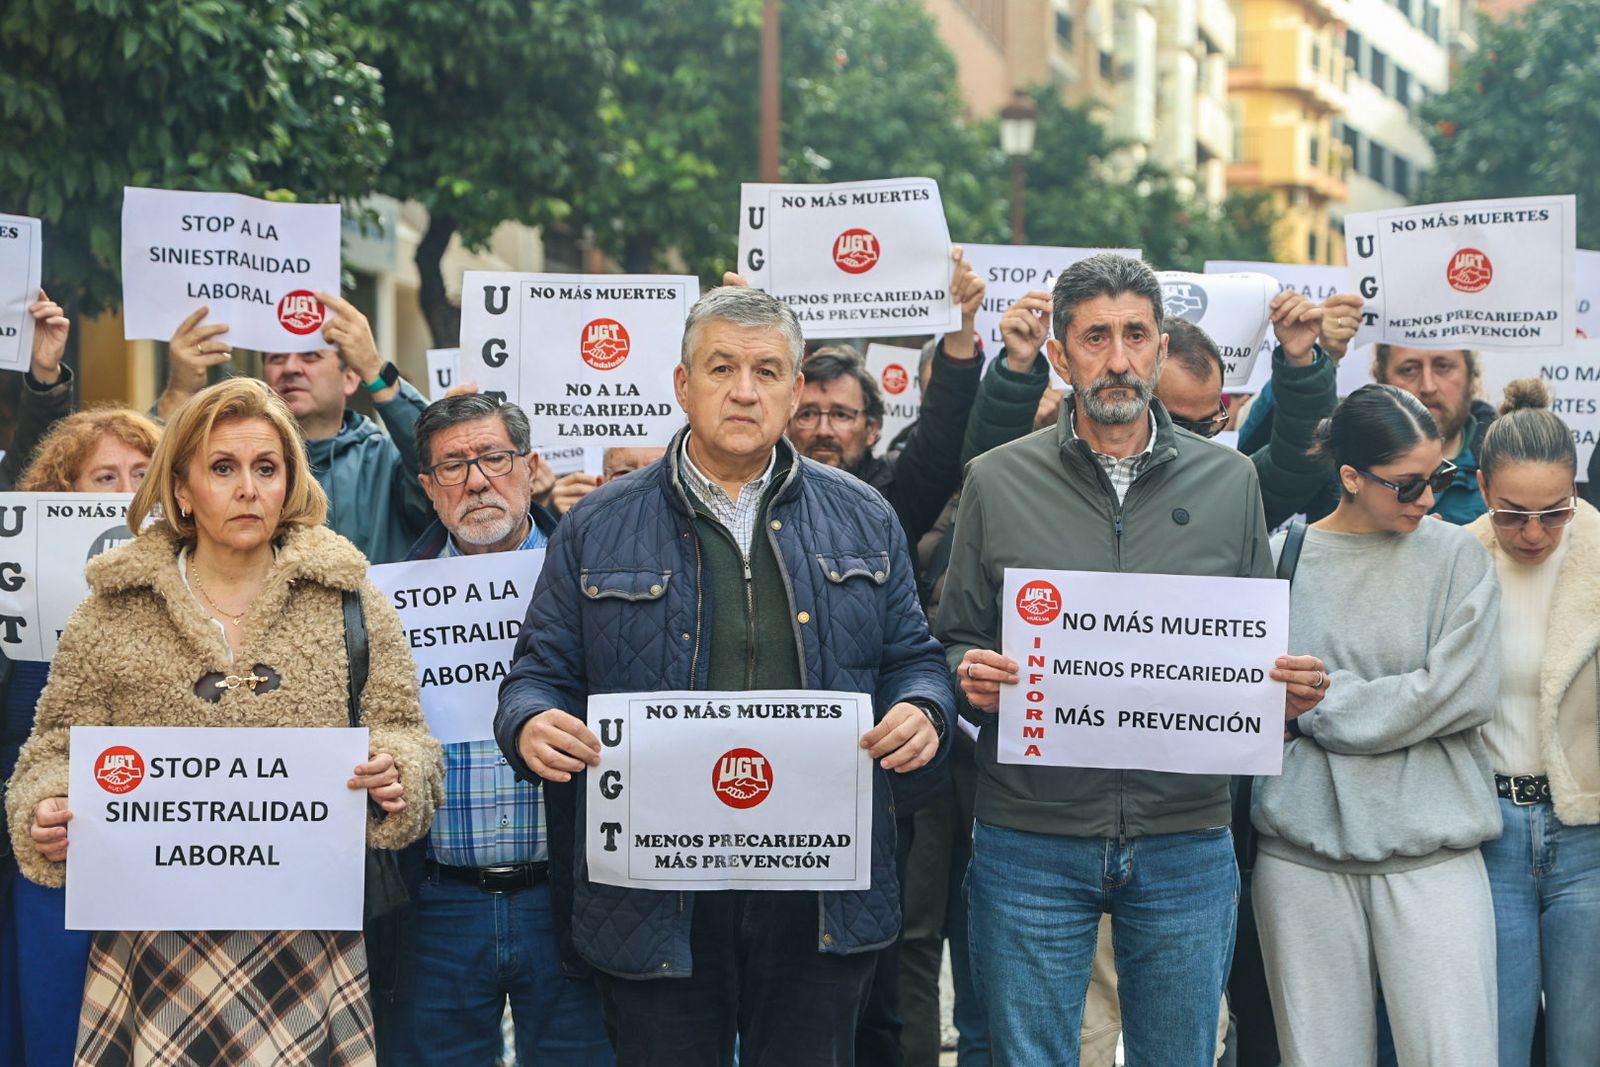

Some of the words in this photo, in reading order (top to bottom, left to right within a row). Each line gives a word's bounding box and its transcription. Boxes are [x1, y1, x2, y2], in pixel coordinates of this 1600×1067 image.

[782, 196, 806, 208] NO
[811, 193, 847, 208] MÁS
[852, 189, 930, 206] MUERTES
[182, 215, 234, 232] STOP
[240, 219, 251, 236] A
[257, 221, 278, 241] LA
[1391, 220, 1416, 233] NO
[1421, 213, 1459, 230] MÁS
[1464, 209, 1549, 225] MUERTES
[838, 234, 873, 255] UGT
[150, 246, 310, 274] SINIESTRALIDAD
[1455, 254, 1484, 270] UGT
[989, 267, 1036, 283] STOP
[187, 282, 274, 306] LABORAL
[530, 287, 555, 299] NO
[559, 285, 592, 300] MÁS
[596, 288, 676, 300] MUERTES
[833, 289, 945, 304] PRECARIEDAD
[283, 295, 318, 315] UGT
[829, 306, 929, 320] PREVENCIÓN
[1389, 313, 1442, 328] MENOS
[1447, 309, 1558, 323] PRECARIEDAD
[588, 324, 619, 342] UGT
[1405, 325, 1437, 339] MÁS
[1442, 324, 1541, 338] PREVENCIÓN
[1541, 366, 1569, 381] NO
[566, 383, 591, 397] NO
[597, 384, 610, 397] A
[616, 384, 640, 397] LA
[534, 403, 672, 417] PRECARIEDAD
[558, 424, 647, 437] LABORAL
[47, 506, 73, 517] NO
[78, 503, 116, 518] MÁS
[394, 585, 457, 610] STOP
[465, 584, 482, 603] A
[489, 580, 519, 600] LA
[1025, 588, 1052, 601] UGT
[403, 620, 523, 648] ESTRALID
[1063, 612, 1096, 631] NO
[1104, 611, 1153, 633] MÁS
[1161, 617, 1267, 638] MUERTES
[421, 660, 514, 688] ABORA
[1053, 659, 1124, 678] MENOS
[1131, 663, 1264, 684] PRECARIEDAD
[646, 704, 678, 720] NO
[684, 701, 731, 719] MÁS
[738, 704, 842, 719] MUERTES
[1055, 705, 1105, 727] MÁS
[1118, 710, 1261, 734] PREVENCIÓN
[104, 755, 135, 770] UGT
[150, 757, 220, 779] STOP
[228, 758, 248, 779] A
[257, 758, 289, 779] LA
[720, 757, 765, 780] UGT
[105, 801, 329, 823] SINIESTRALIDAD
[635, 834, 703, 848] MENOS
[708, 834, 851, 848] PRECARIEDAD
[155, 844, 280, 867] LABORAL
[655, 852, 697, 869] MÁS
[702, 852, 830, 869] PREVENCIÓN
